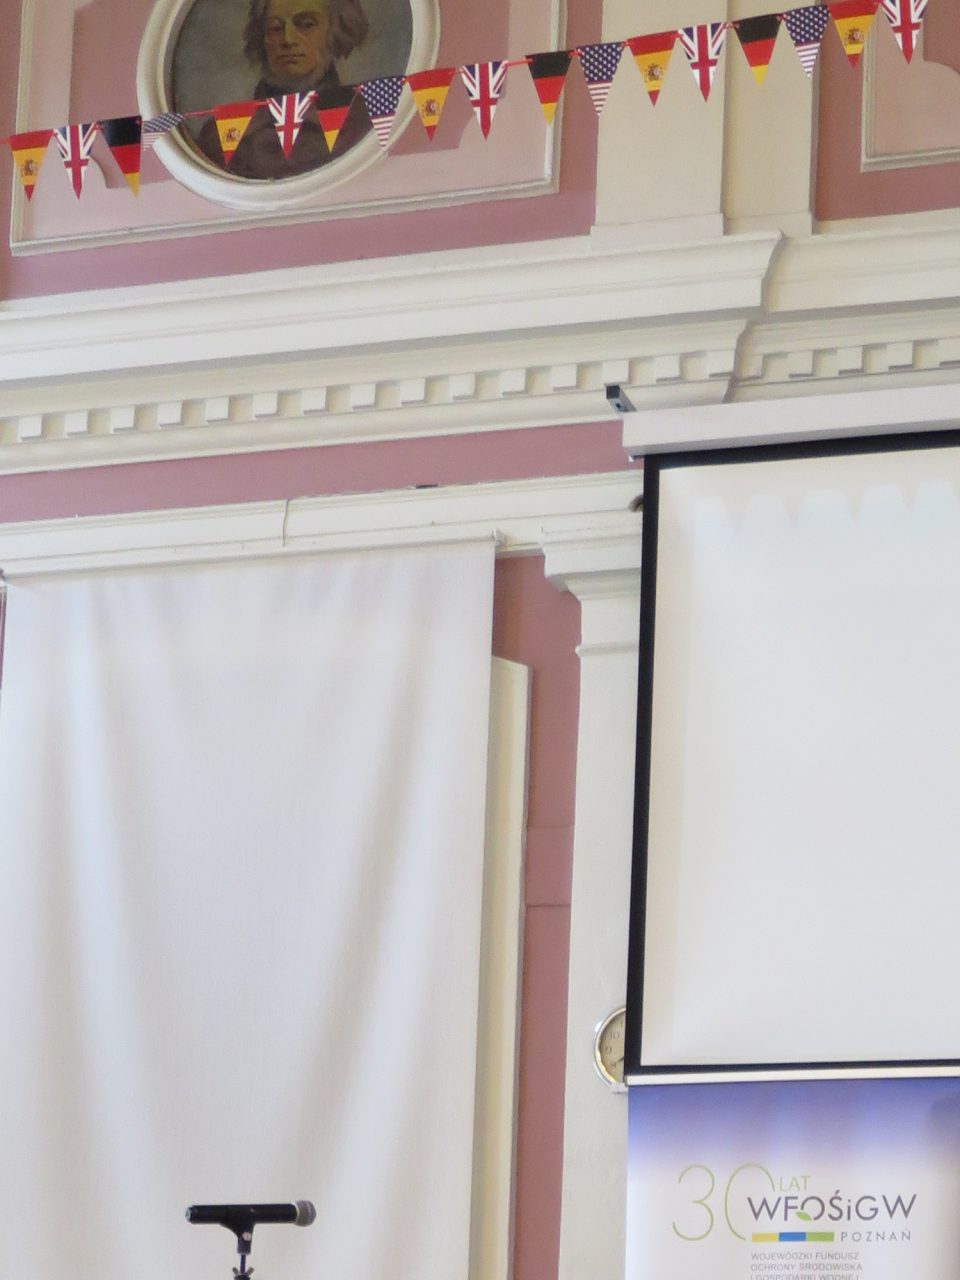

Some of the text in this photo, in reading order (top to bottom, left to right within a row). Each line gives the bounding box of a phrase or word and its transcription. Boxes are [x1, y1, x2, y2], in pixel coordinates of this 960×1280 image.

[673, 1164, 811, 1241] 30 LAT
[747, 1189, 917, 1221] WFOŚiGW
[840, 1228, 912, 1242] POZNAŃ
[751, 1251, 860, 1261] WOJEWÓDZKI FUNDUSZ
[750, 1261, 863, 1272] OCHRONY ŚRODOWISKA
